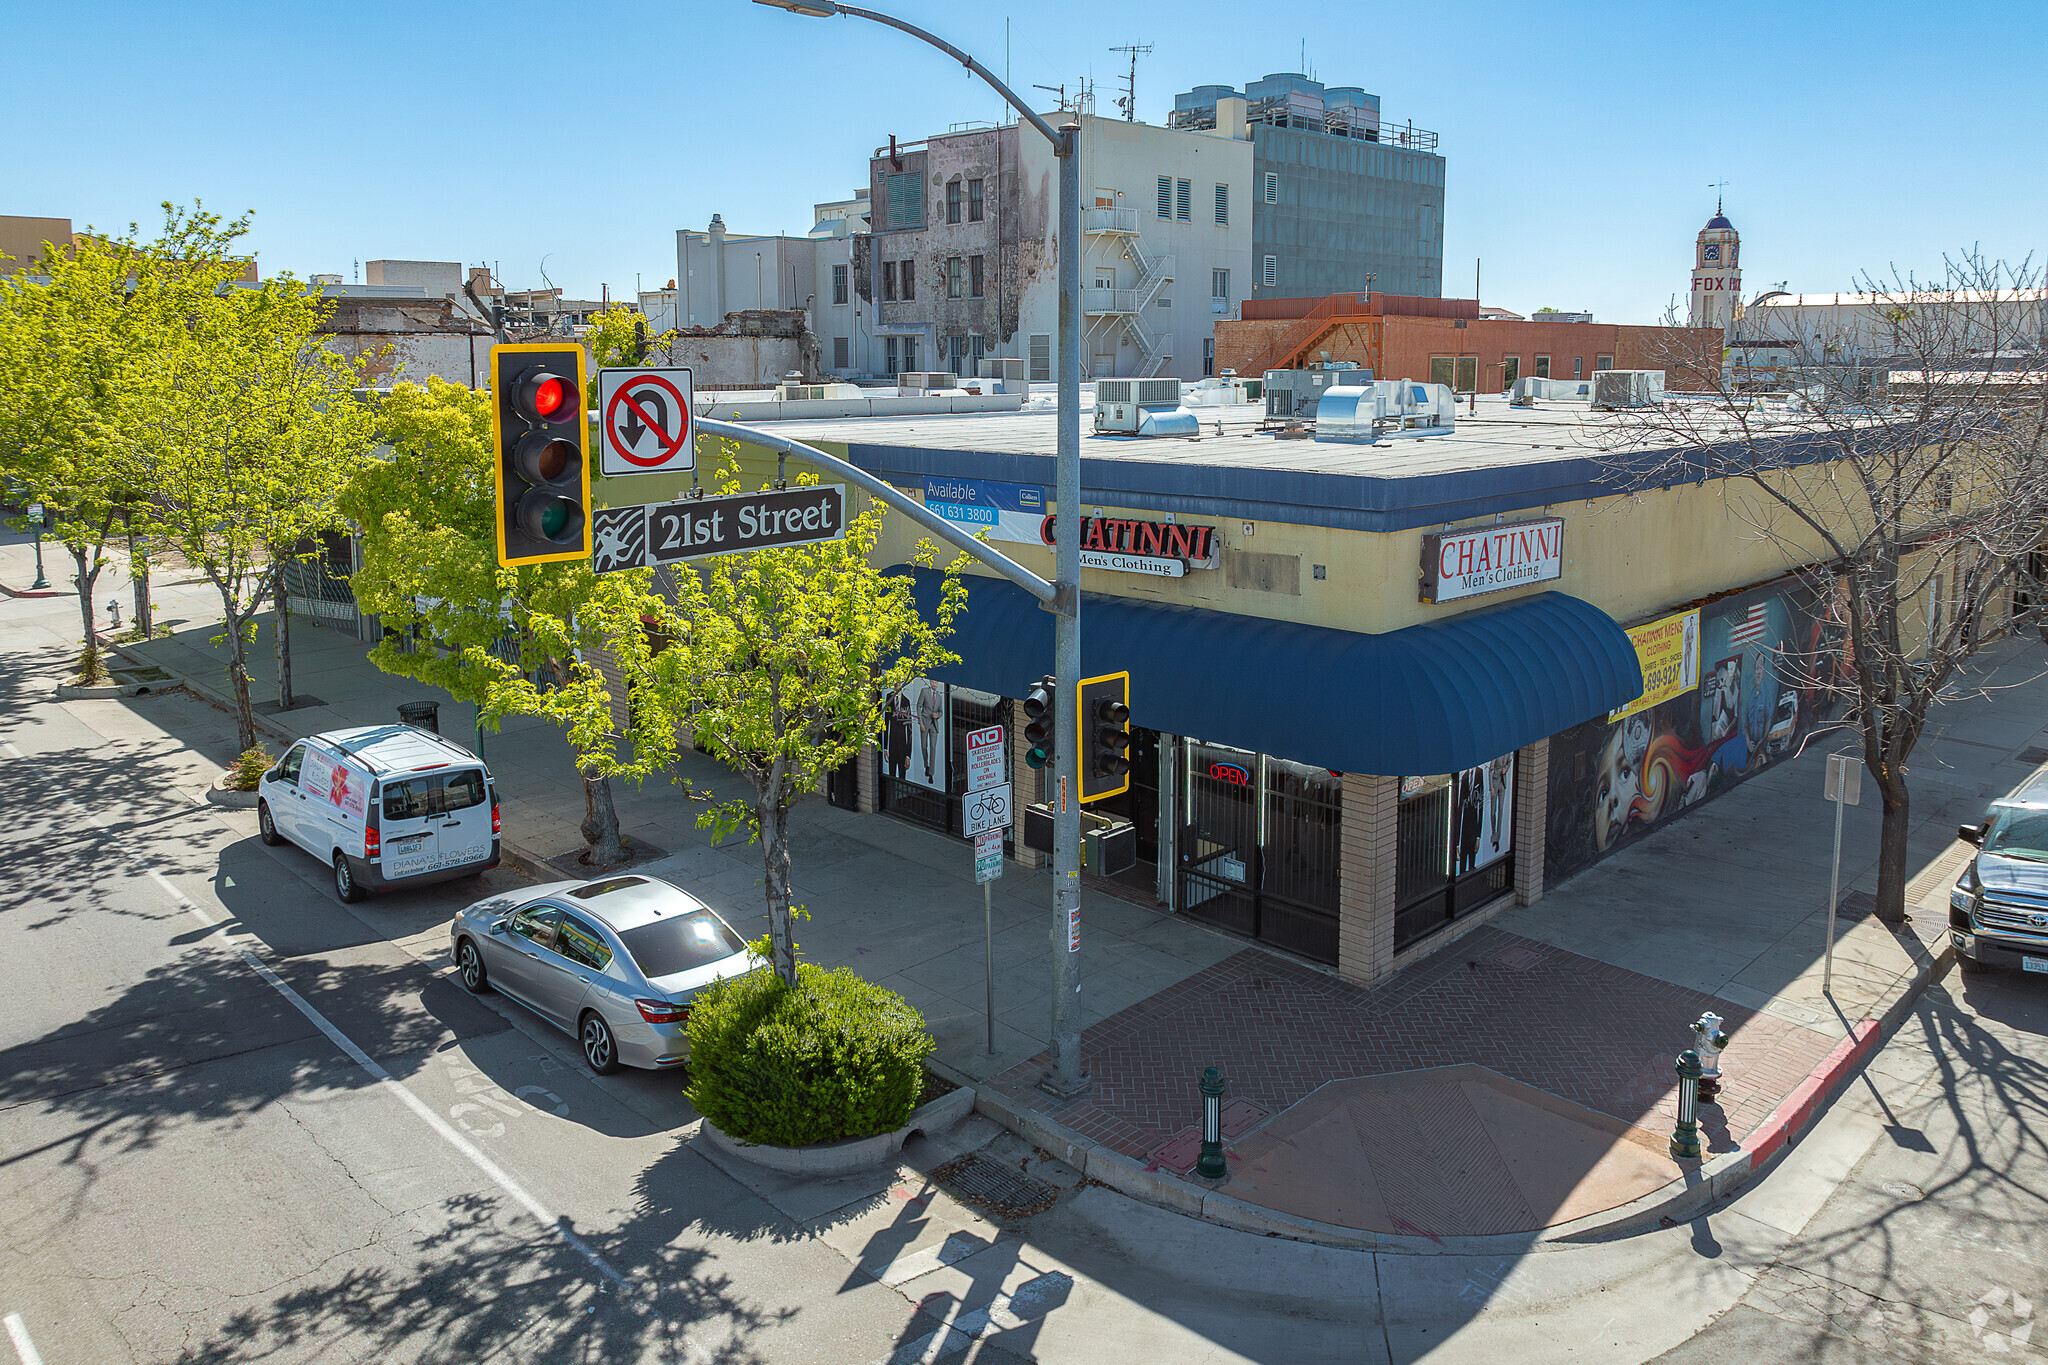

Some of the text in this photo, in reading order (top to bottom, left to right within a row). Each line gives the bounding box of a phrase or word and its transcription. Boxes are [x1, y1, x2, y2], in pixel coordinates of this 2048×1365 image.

[1694, 277, 1725, 291] FOX
[927, 481, 976, 500] Available
[947, 506, 963, 519] 631
[967, 508, 992, 522] 3800
[659, 498, 832, 549] 21st Street
[1440, 525, 1560, 579] CHATINNI
[1111, 556, 1172, 576] Clothing
[1461, 564, 1540, 590] Men's Clothing
[1665, 620, 1683, 638] MENS
[1646, 640, 1671, 657] CLOTHING
[1670, 652, 1682, 663] SHOES
[971, 730, 999, 747] NO
[971, 744, 1000, 757] SKATEBOARDS
[976, 752, 996, 762] BICYCLES
[971, 757, 1001, 770] ROLLERBLADES
[976, 772, 997, 782] SIDEWALK
[1210, 764, 1247, 786] OPEN
[1401, 776, 1424, 793] OPEN
[971, 815, 1006, 832] BIKE LANE
[977, 832, 1001, 847] NO PARKING
[393, 844, 486, 870] DIANA'S FLOWERS
